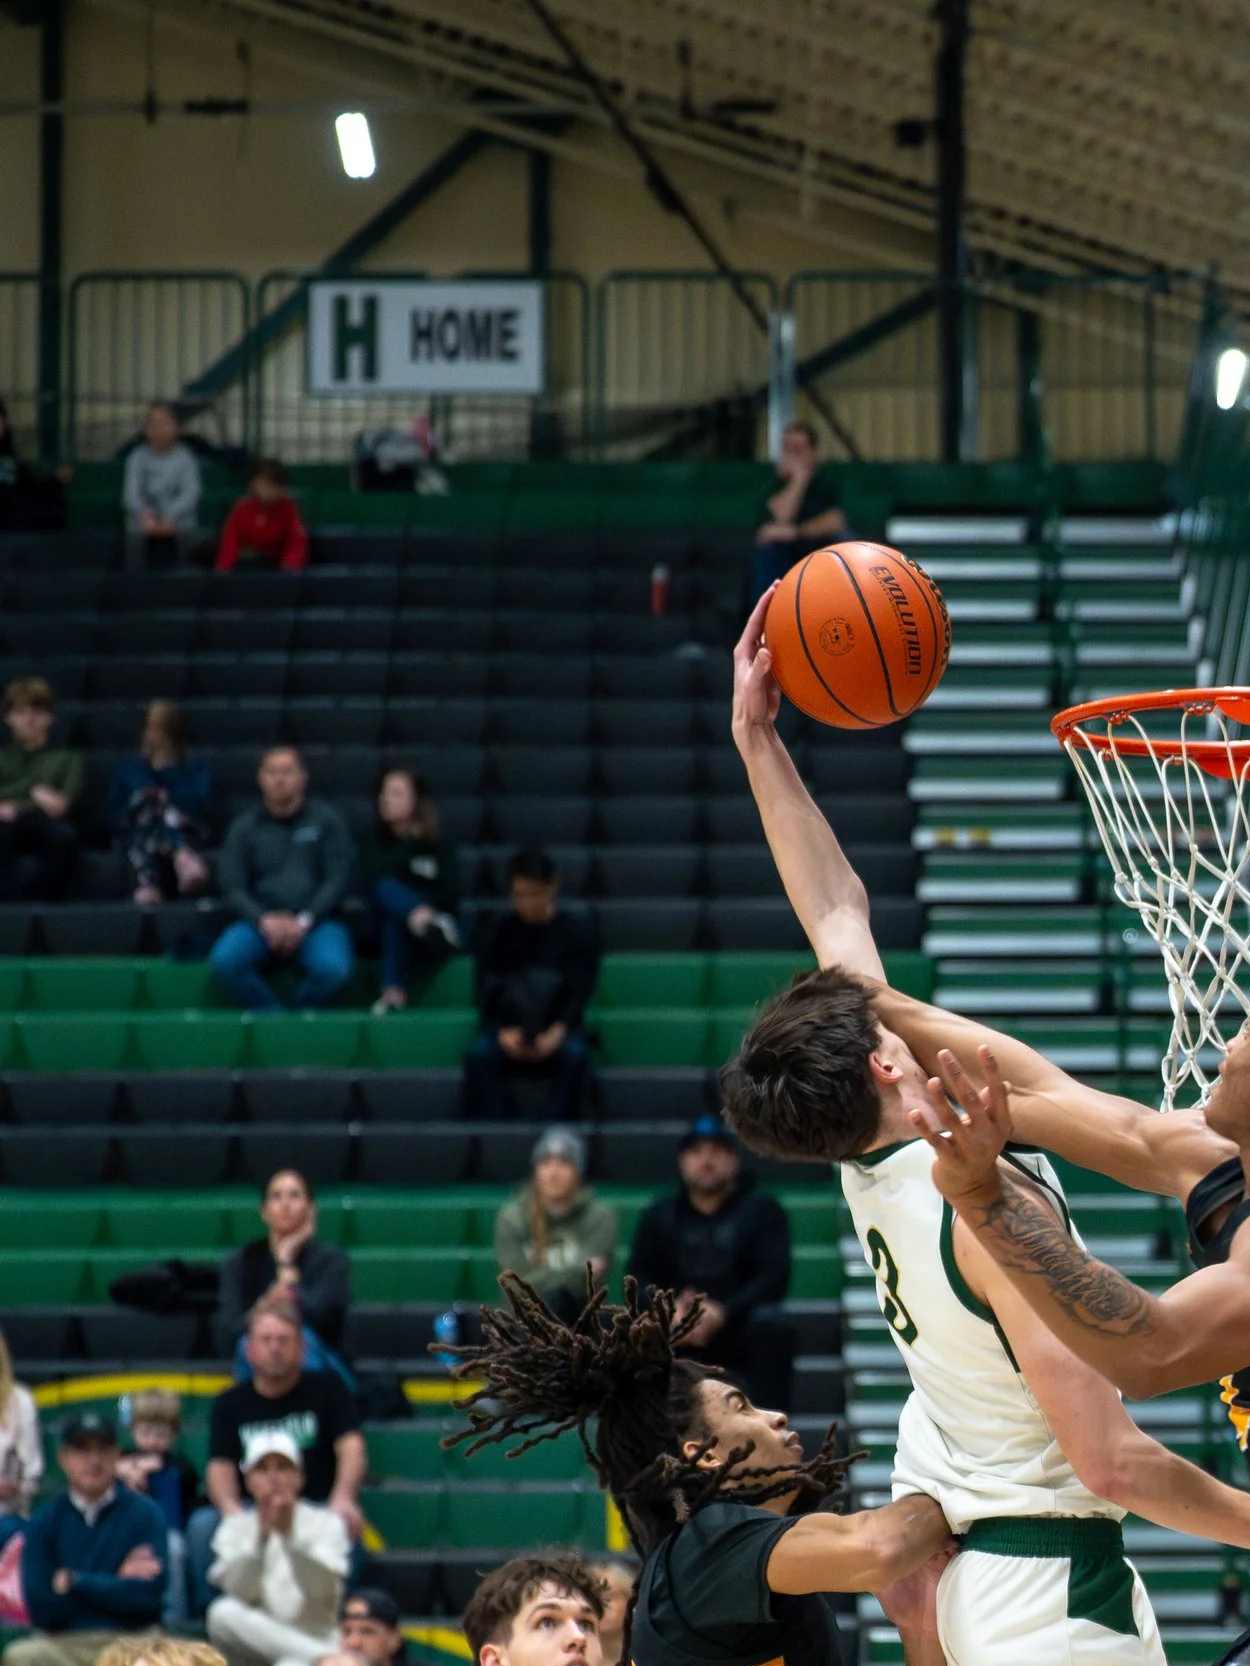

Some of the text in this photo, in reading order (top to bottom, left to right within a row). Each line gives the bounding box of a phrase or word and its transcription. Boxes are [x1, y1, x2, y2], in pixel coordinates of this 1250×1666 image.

[333, 296, 523, 382] H HOME
[874, 565, 922, 676] EVOLUTION
